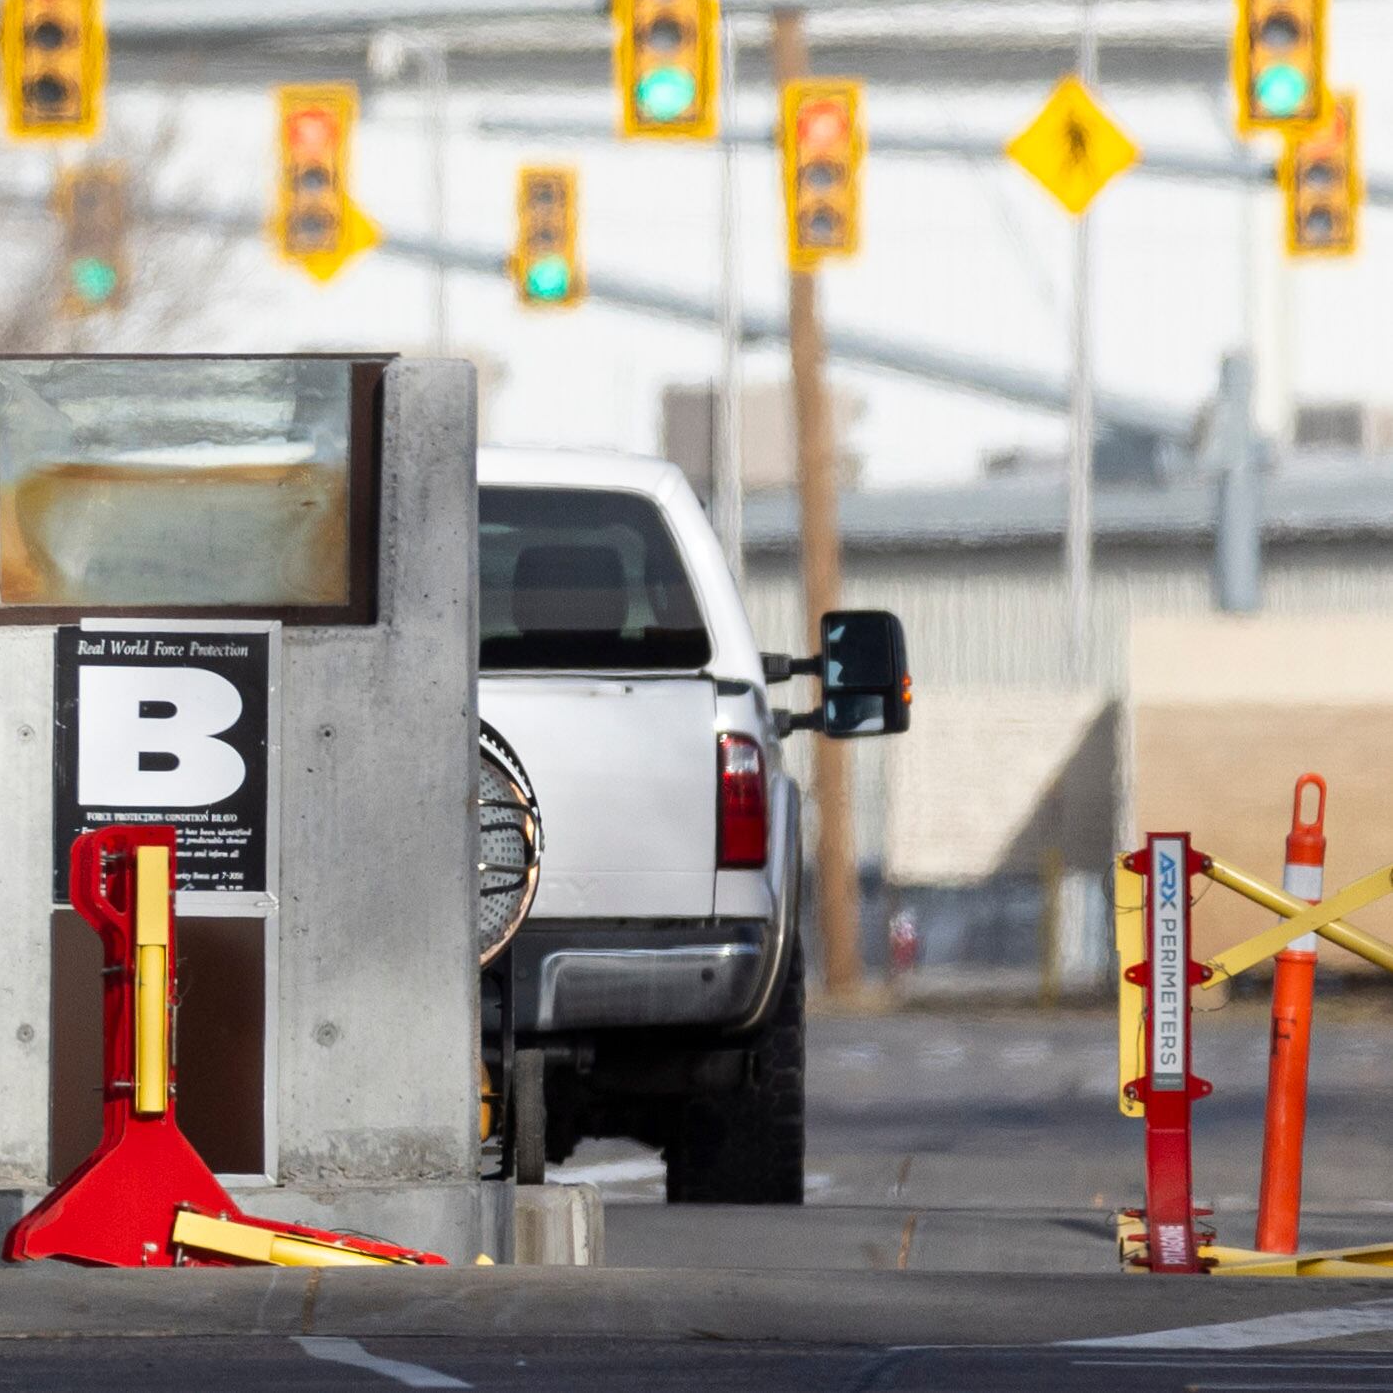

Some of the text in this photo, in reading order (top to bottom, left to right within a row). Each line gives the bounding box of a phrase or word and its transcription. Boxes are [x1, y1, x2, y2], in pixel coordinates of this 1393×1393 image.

[77, 639, 249, 657] Real World Force Protection
[78, 665, 246, 807] B
[114, 813, 163, 822] PROTECTION
[165, 813, 209, 822] CONDITION
[211, 814, 237, 822] BRAVO
[1159, 852, 1177, 909] ARX
[1160, 918, 1177, 1065] PERIMETERS
